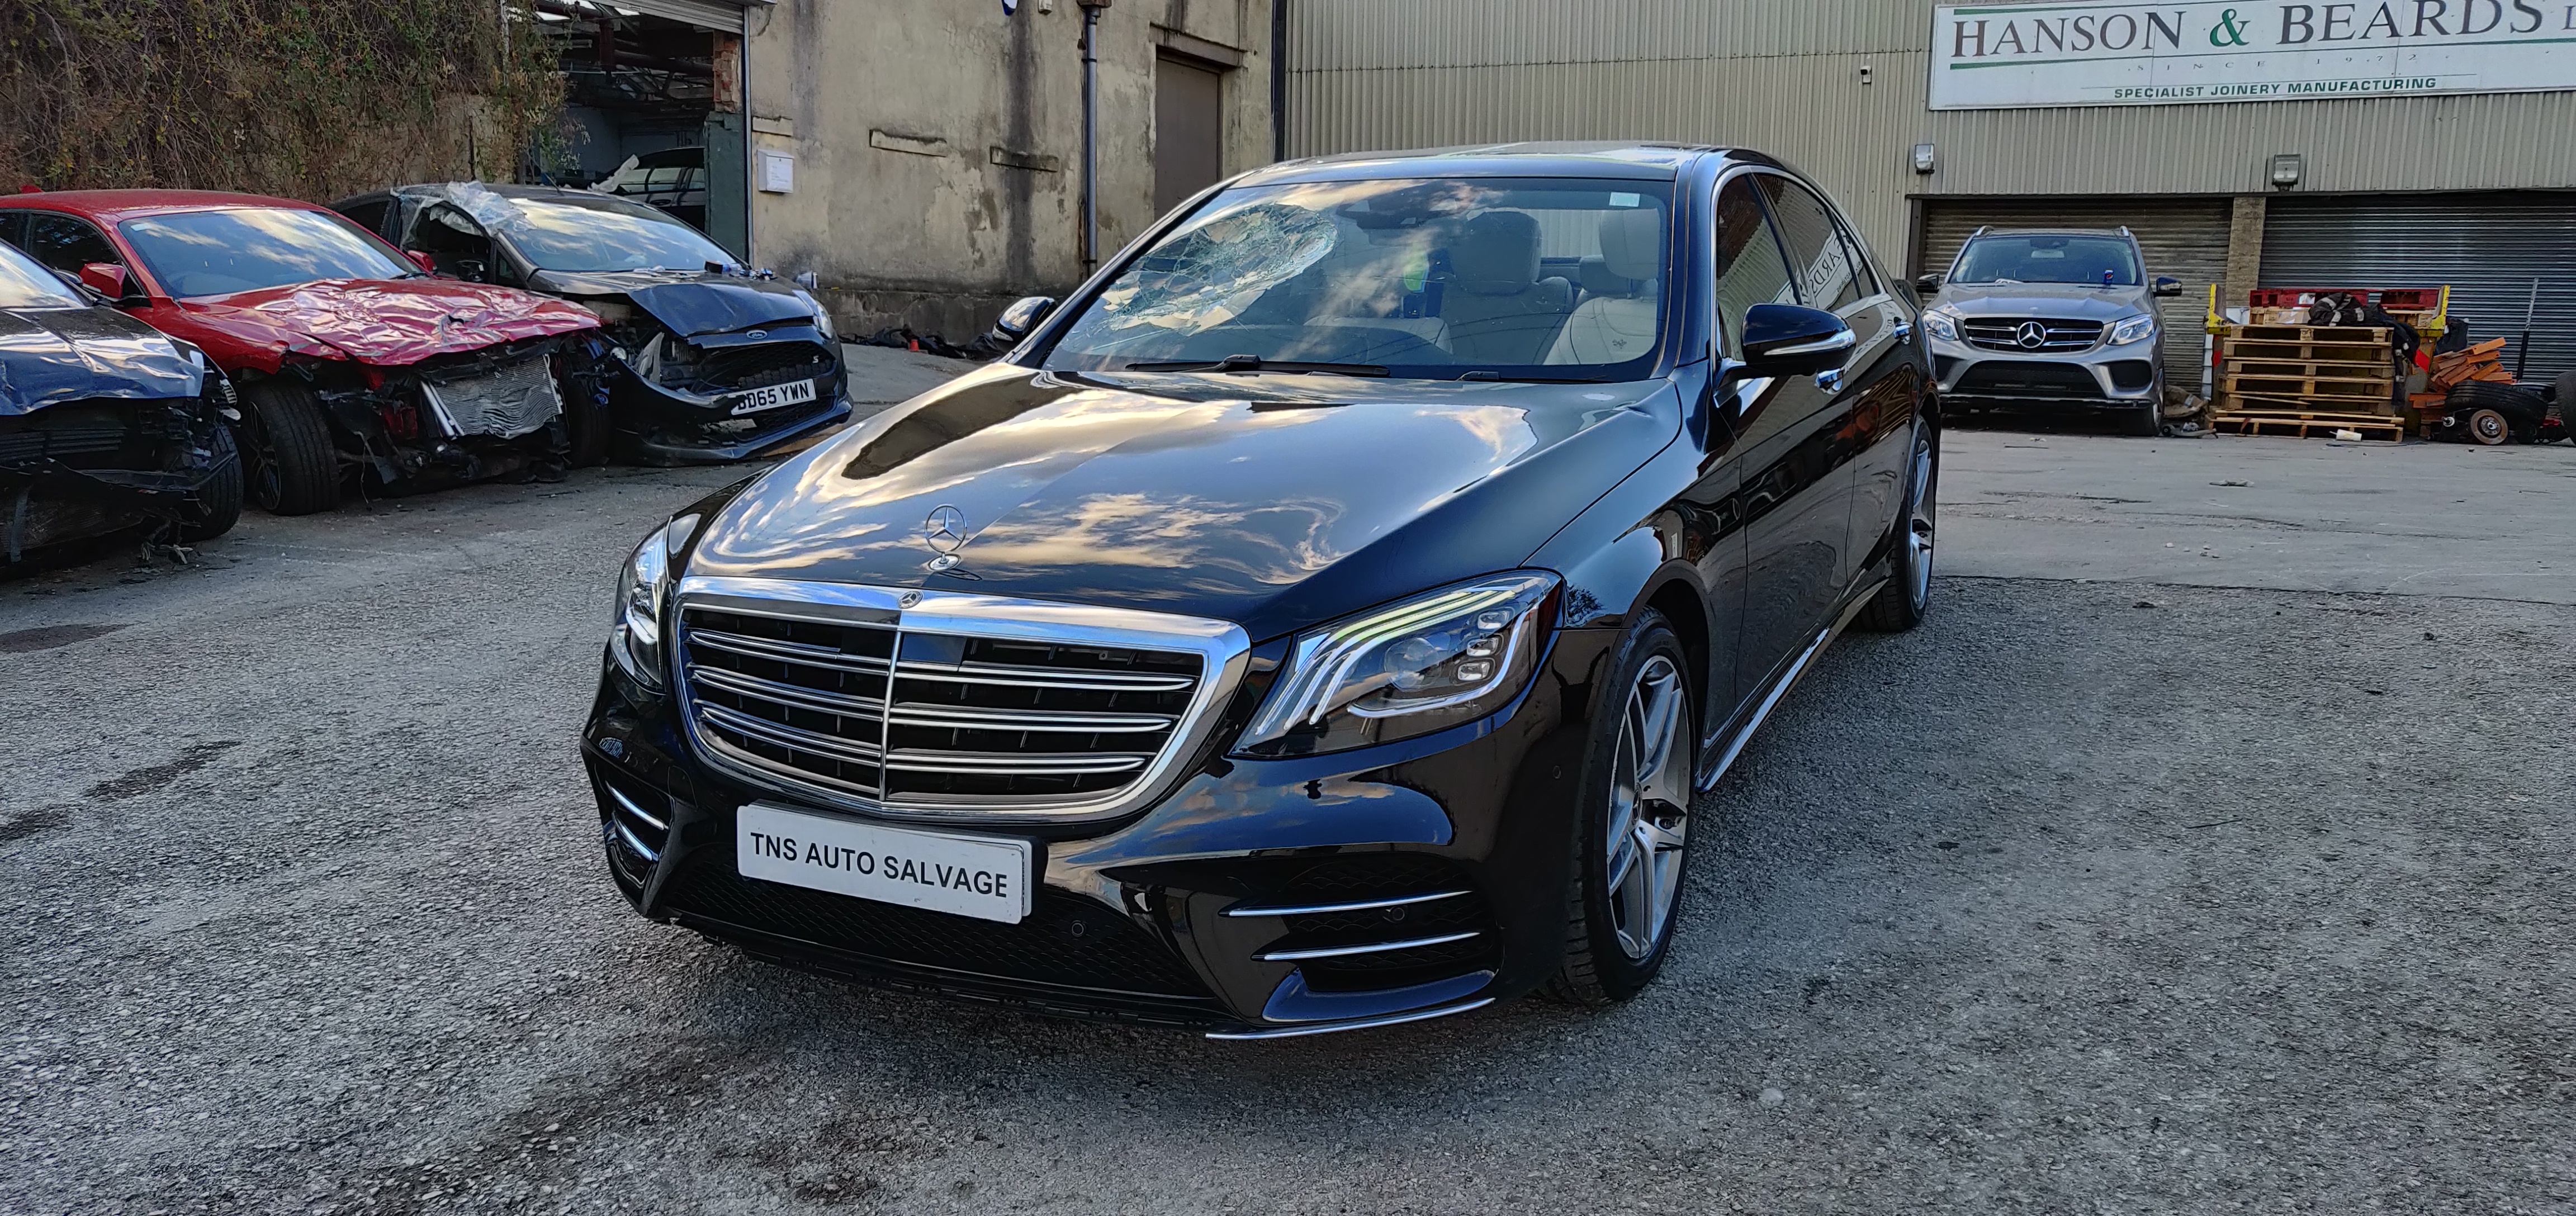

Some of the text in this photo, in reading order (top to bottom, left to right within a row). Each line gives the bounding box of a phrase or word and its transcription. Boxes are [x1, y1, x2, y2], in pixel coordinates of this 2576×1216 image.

[1950, 11, 2187, 58] HANSON
[2209, 8, 2251, 47] &
[2276, 0, 2543, 45] BEARDS
[2114, 78, 2436, 98] SPECIALIST JOINERY MANUFACTURING
[780, 382, 809, 402] YWN
[750, 832, 1007, 898] TNS AUTO SALVAGE
